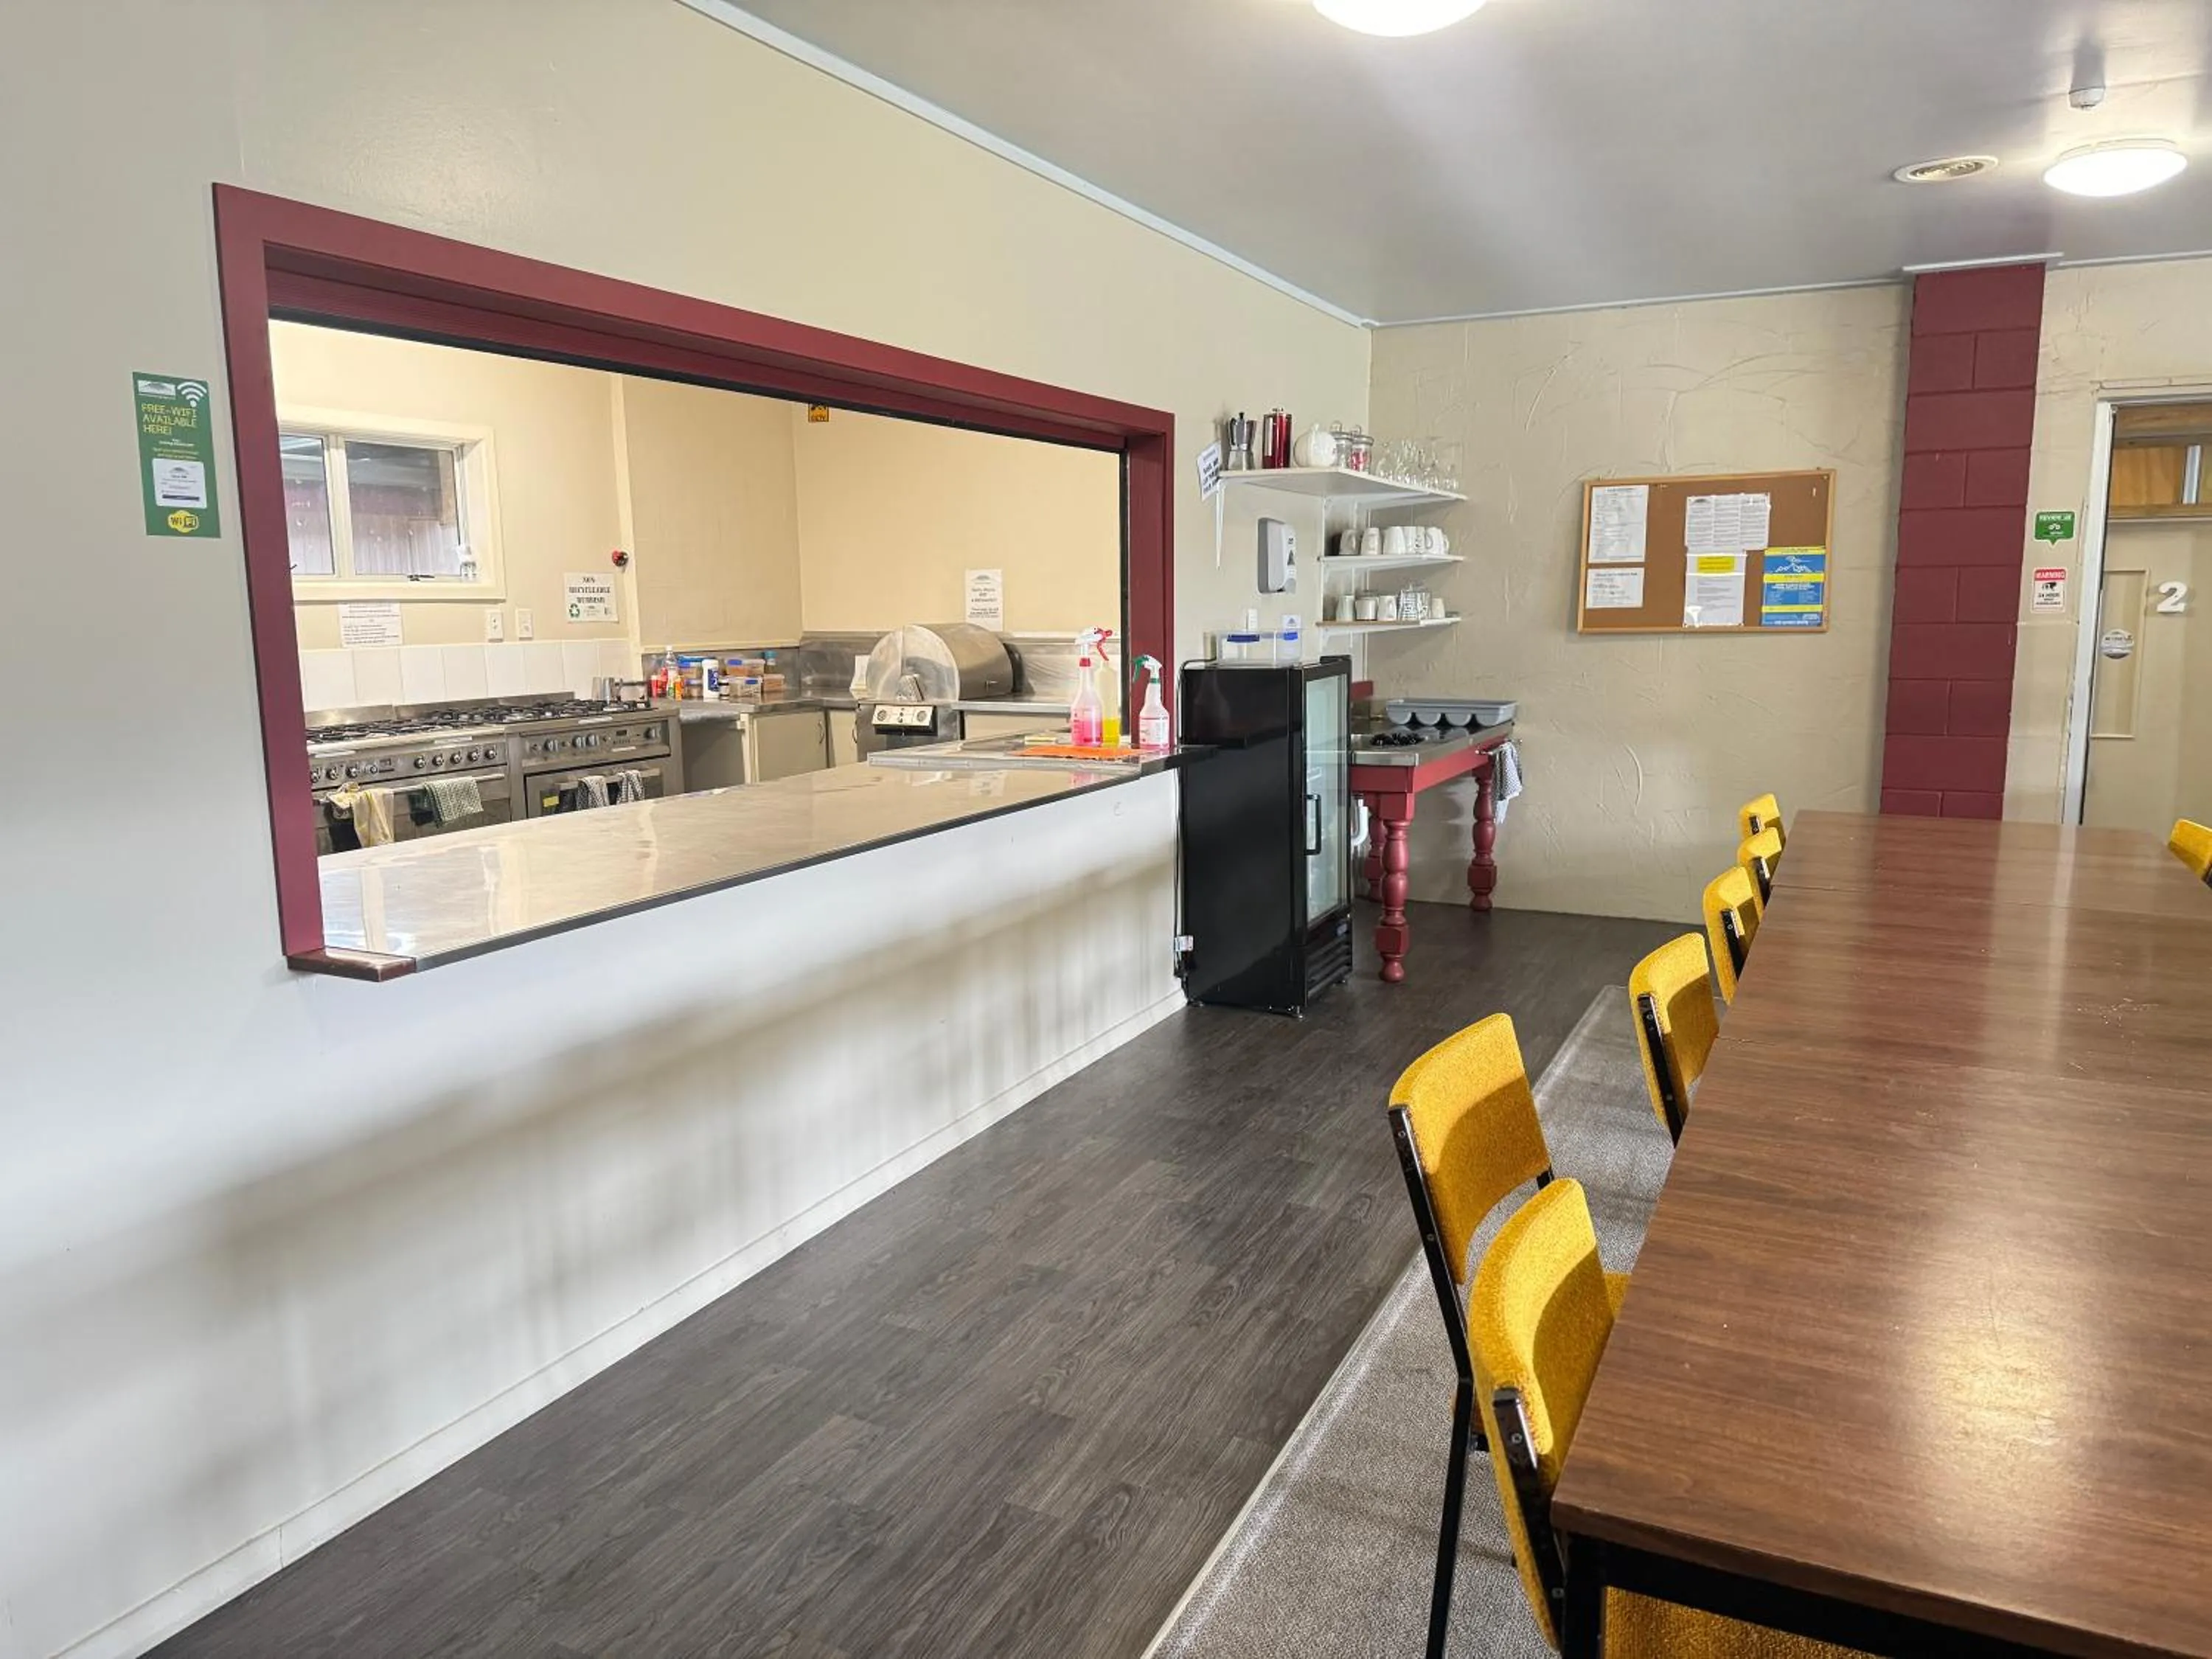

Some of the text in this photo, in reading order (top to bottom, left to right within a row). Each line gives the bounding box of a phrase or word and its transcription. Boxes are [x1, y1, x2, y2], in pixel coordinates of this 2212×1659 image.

[142, 414, 198, 428] AVAILABLE
[2035, 571, 2065, 579] WARNING
[2157, 581, 2188, 613] 2
